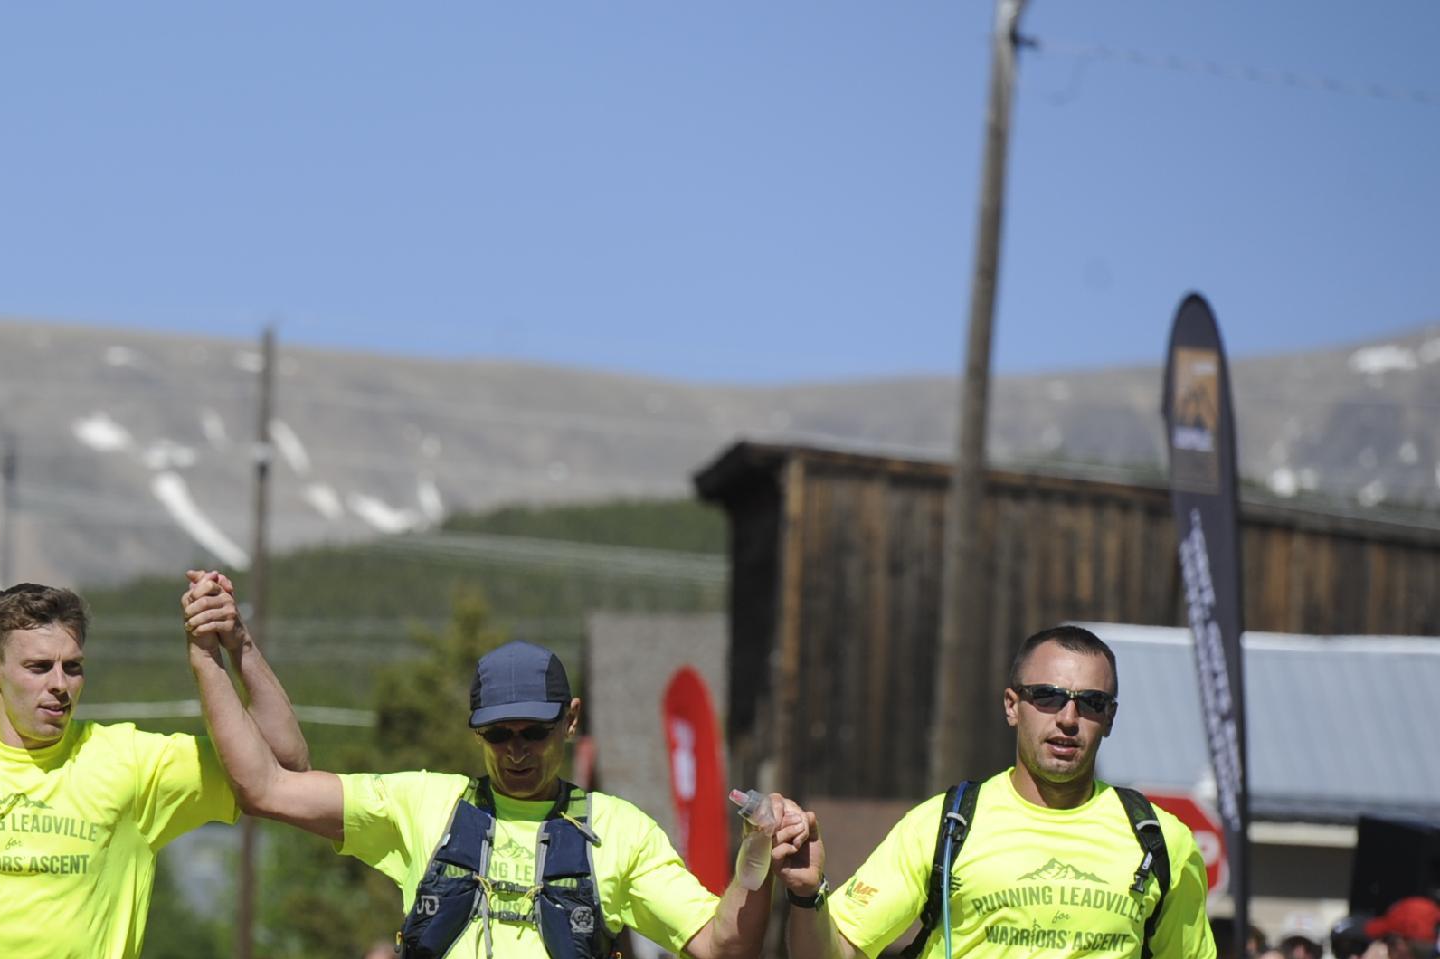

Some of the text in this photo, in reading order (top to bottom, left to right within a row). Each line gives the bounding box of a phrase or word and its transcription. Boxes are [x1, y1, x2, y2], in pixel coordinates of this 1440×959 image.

[11, 812, 99, 842] LEADVILLE
[28, 854, 91, 875] ASCENT
[971, 885, 1146, 924] RUNNING LEADVILLE
[1051, 910, 1071, 924] for
[1072, 931, 1131, 952] ASCENT
